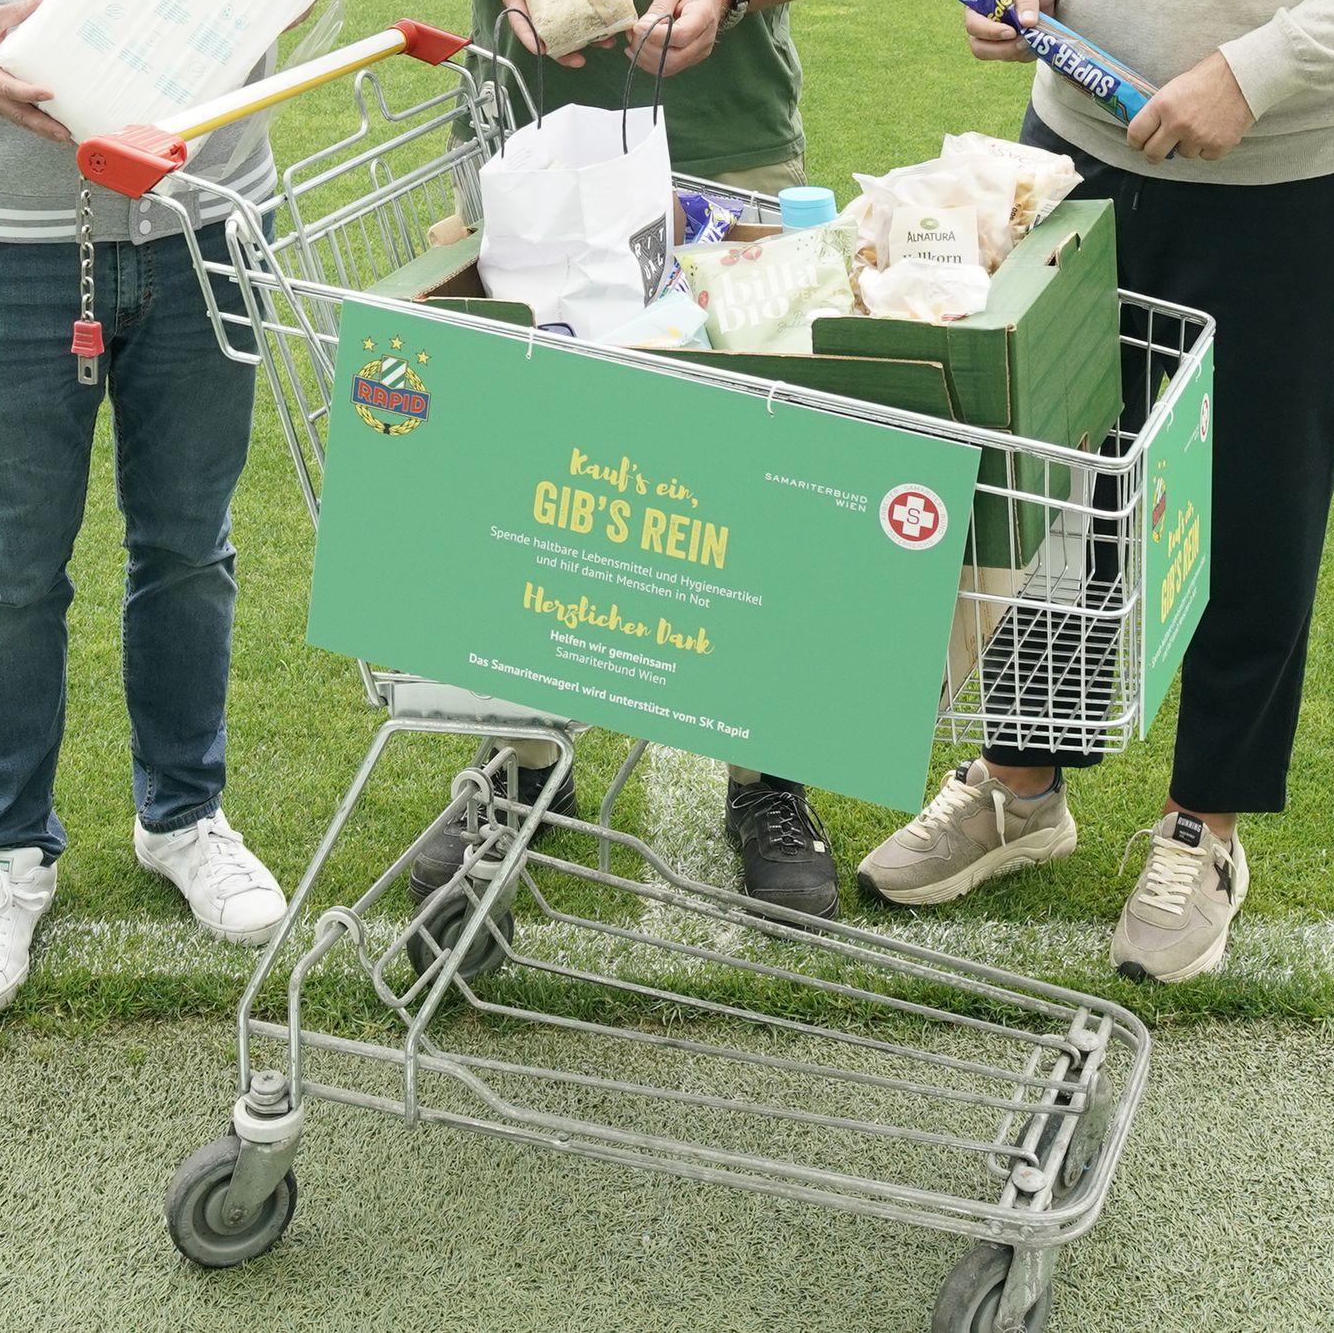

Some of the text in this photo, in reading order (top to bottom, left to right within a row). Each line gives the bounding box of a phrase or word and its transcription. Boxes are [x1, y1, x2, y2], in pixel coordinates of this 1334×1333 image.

[1021, 27, 1115, 98] SUPER SIZ
[907, 231, 956, 243] ALNATURA
[717, 264, 820, 307] billa
[713, 295, 789, 335] bio
[357, 378, 428, 416] RAPID
[569, 447, 699, 509] Kauf's ein,
[764, 472, 868, 504] SAMARITERBUND
[533, 480, 729, 570] GIB'S REIN
[835, 498, 867, 513] WIEN
[906, 507, 921, 525] S
[490, 525, 763, 607] Spende haltbare Lebensmittel und Hygieneartikel
[536, 555, 711, 609] und hilf damit Menschen in Not
[523, 581, 714, 655] Herzlichen Dank
[550, 629, 677, 673] Helfen wir gemeinsam!
[555, 646, 667, 686] Samariterbund Wien
[468, 652, 750, 739] Das Samariterwagerl wird unterstützt vom SK Rapid
